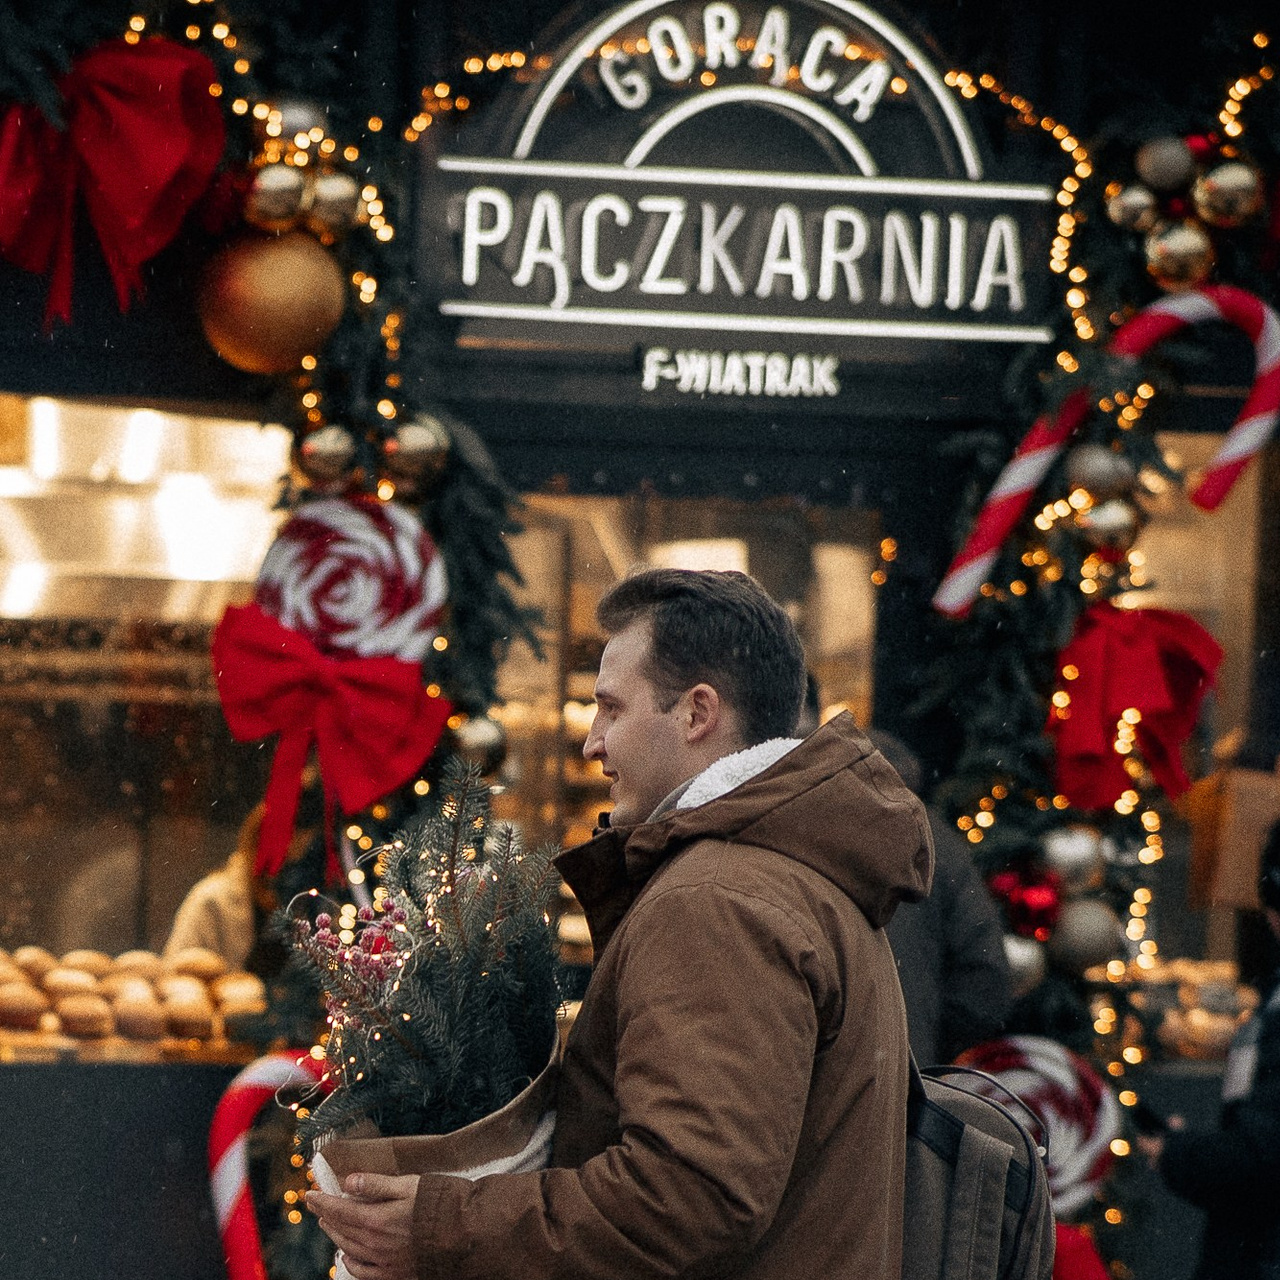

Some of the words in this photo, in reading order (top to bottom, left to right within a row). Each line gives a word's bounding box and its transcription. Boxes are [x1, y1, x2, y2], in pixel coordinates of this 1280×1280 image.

[599, 2, 891, 122] GORĄCA
[463, 187, 1024, 310] PĄCZKARNIA
[642, 349, 839, 396] F-WIATRAK
